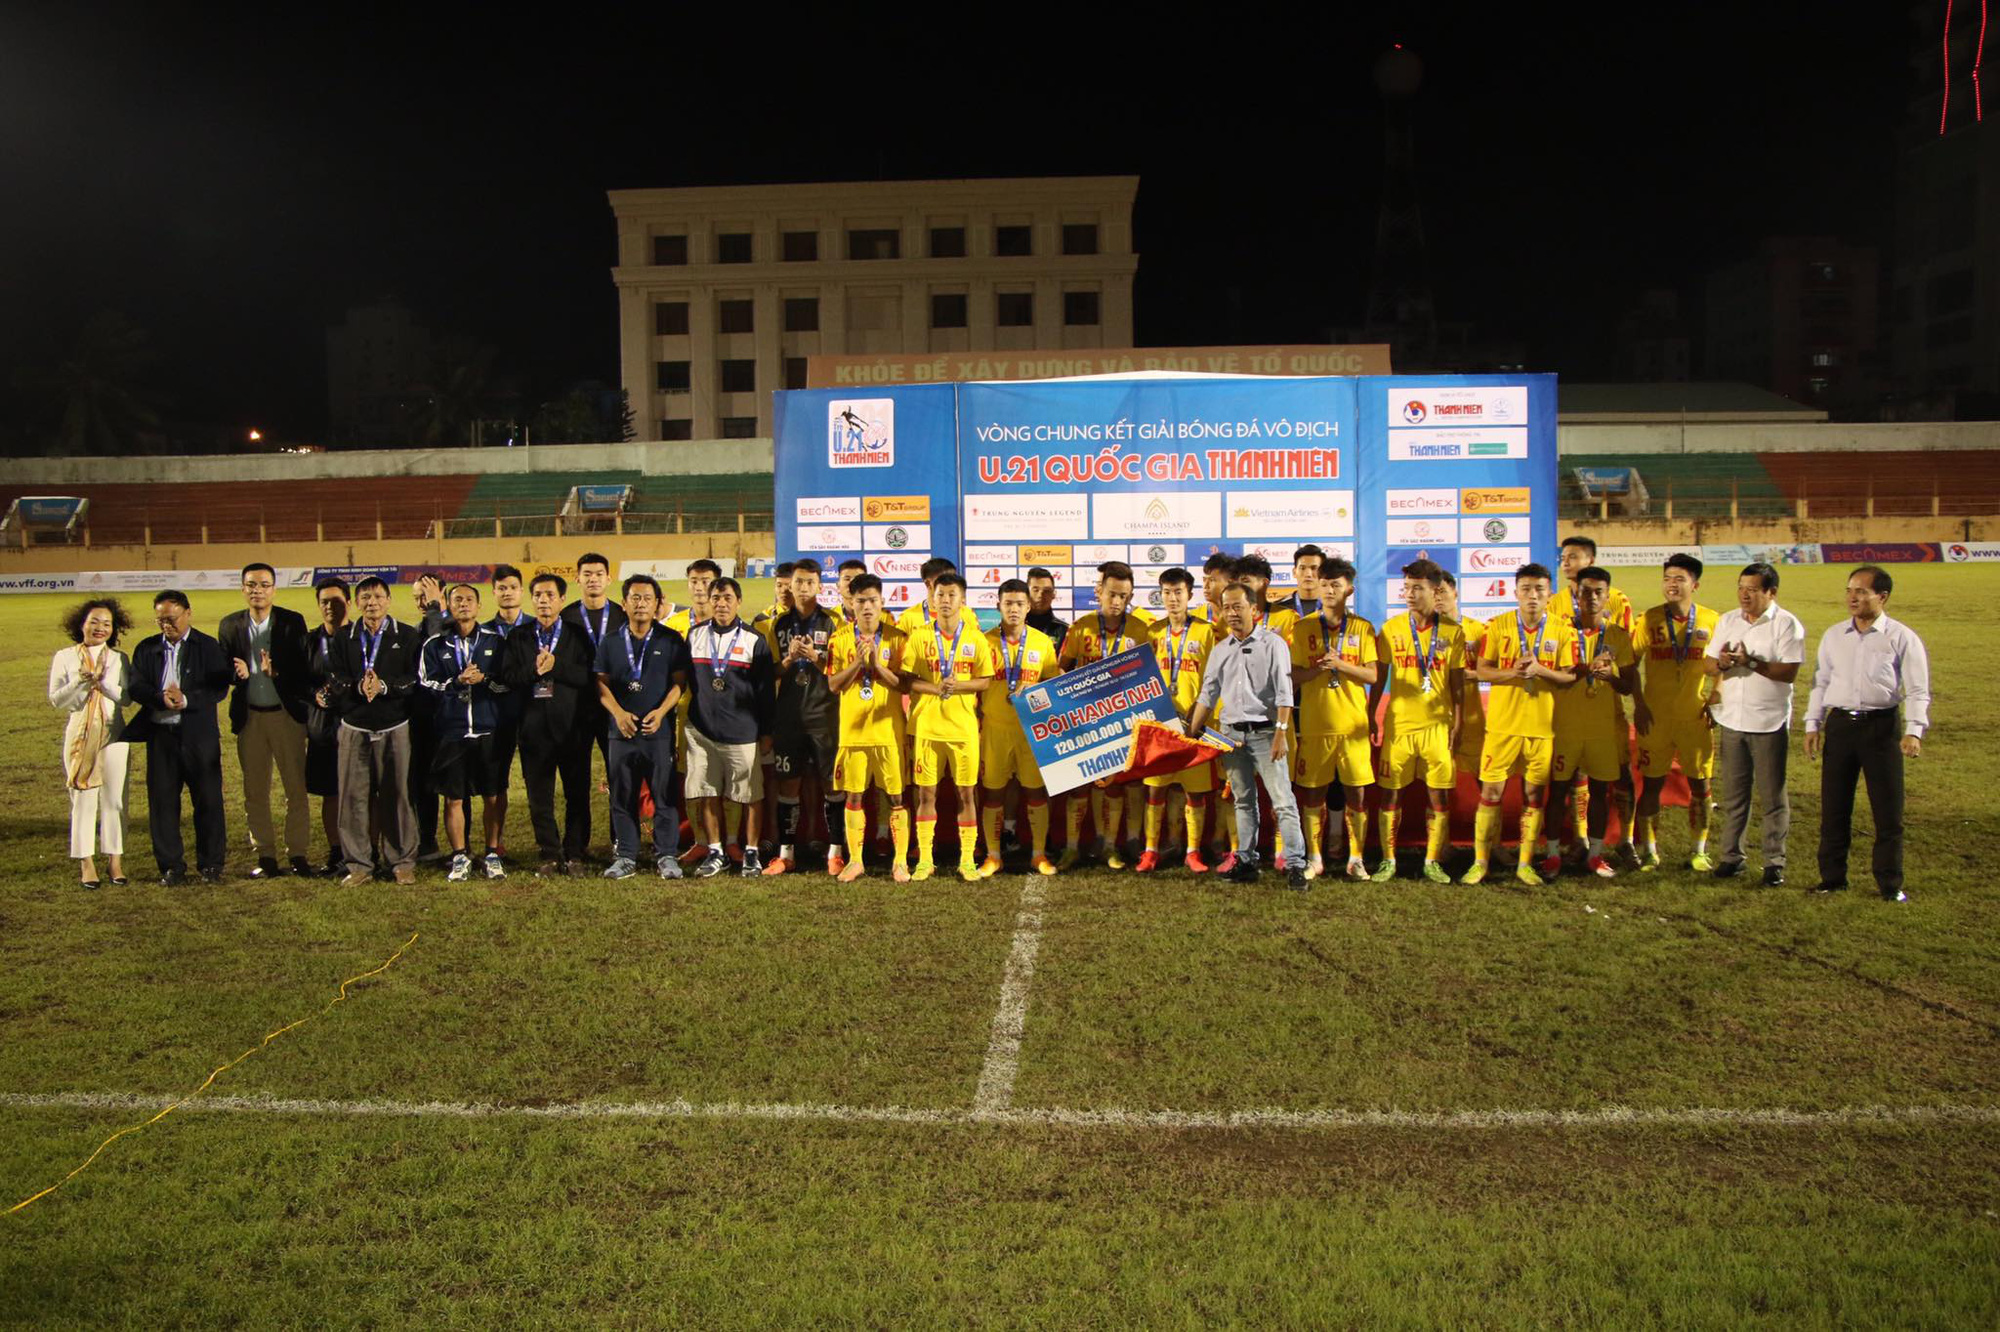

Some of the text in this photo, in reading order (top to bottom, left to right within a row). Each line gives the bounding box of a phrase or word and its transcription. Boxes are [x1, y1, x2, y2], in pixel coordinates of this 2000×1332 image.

[977, 418, 1339, 442] VÒNG CHUNG KẾT GIẢI BÓNG ĐÁ VÔ ĐỊCH
[978, 454, 1040, 484] U.21
[1043, 444, 1142, 485] QUỐC
[1145, 452, 1205, 482] GIA
[1502, 636, 1511, 653] 7
[1031, 719, 1070, 742] ĐỘI
[1068, 690, 1129, 727] HẠNG
[1054, 721, 1123, 755] 120.000.000
[775, 755, 791, 772] 26
